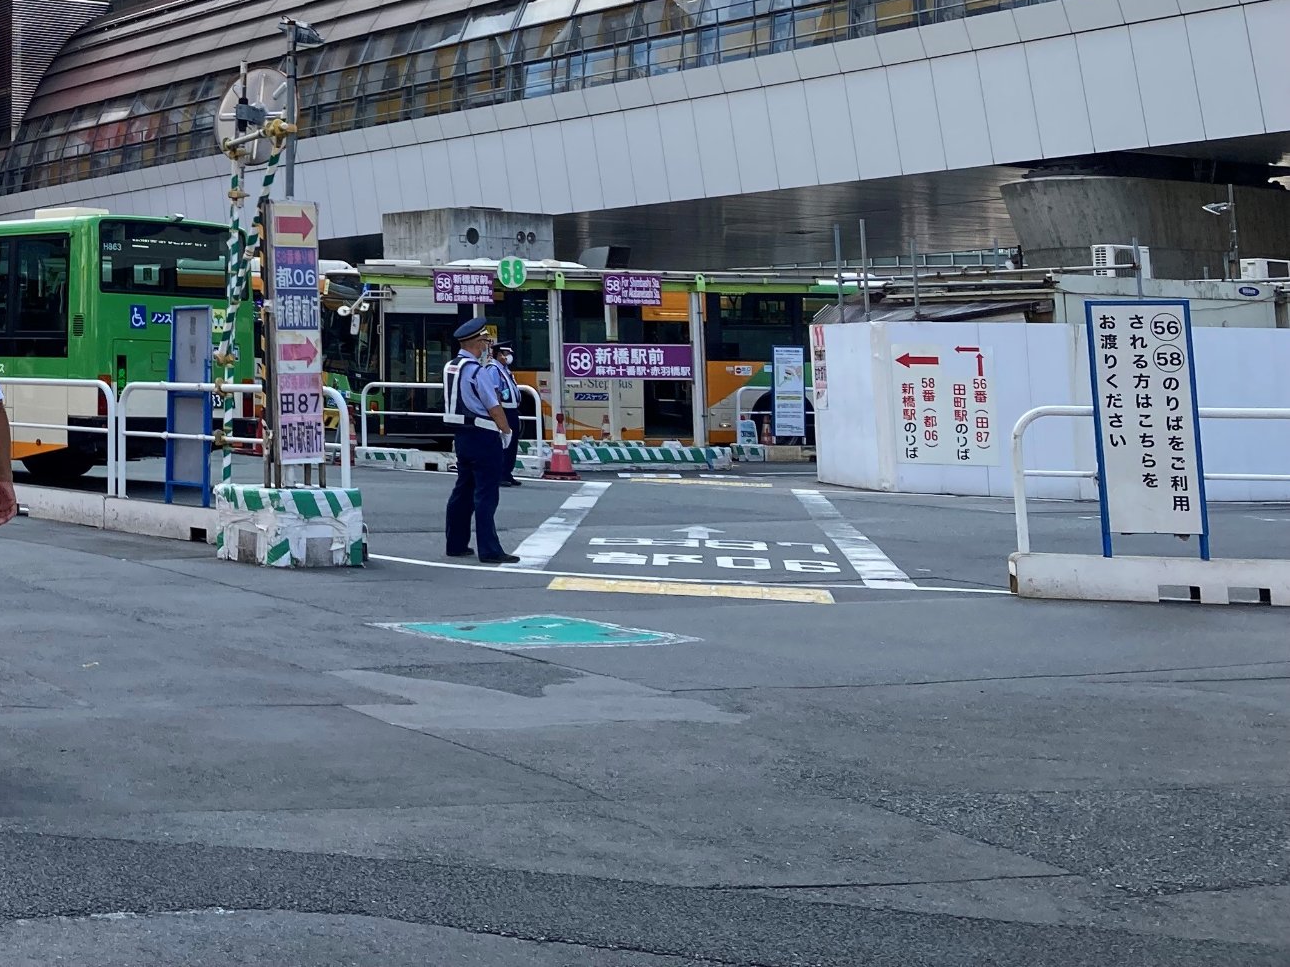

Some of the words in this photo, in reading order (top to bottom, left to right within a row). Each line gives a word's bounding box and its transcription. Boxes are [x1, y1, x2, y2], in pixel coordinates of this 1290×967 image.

[276, 266, 316, 288] 都06
[437, 277, 451, 289] 58
[606, 279, 620, 291] 58
[436, 292, 453, 302] 都06
[151, 313, 172, 323] ノンス
[277, 294, 318, 327] 新橋駅前行
[1153, 321, 1179, 335] 56
[570, 353, 591, 370] 58
[595, 347, 664, 365] 新橋駅前
[1156, 353, 1182, 366] 58
[595, 366, 691, 376] 麻布十番駅・赤羽橋駅
[1099, 314, 1126, 447] お渡りください
[280, 392, 320, 414] 田87
[1128, 314, 1158, 488] される方はこちらを
[901, 382, 918, 459] 新橋駅のりば
[953, 384, 970, 460] 田町駅のりば
[281, 421, 322, 453] 田町駅前行
[586, 551, 841, 573] 都06
